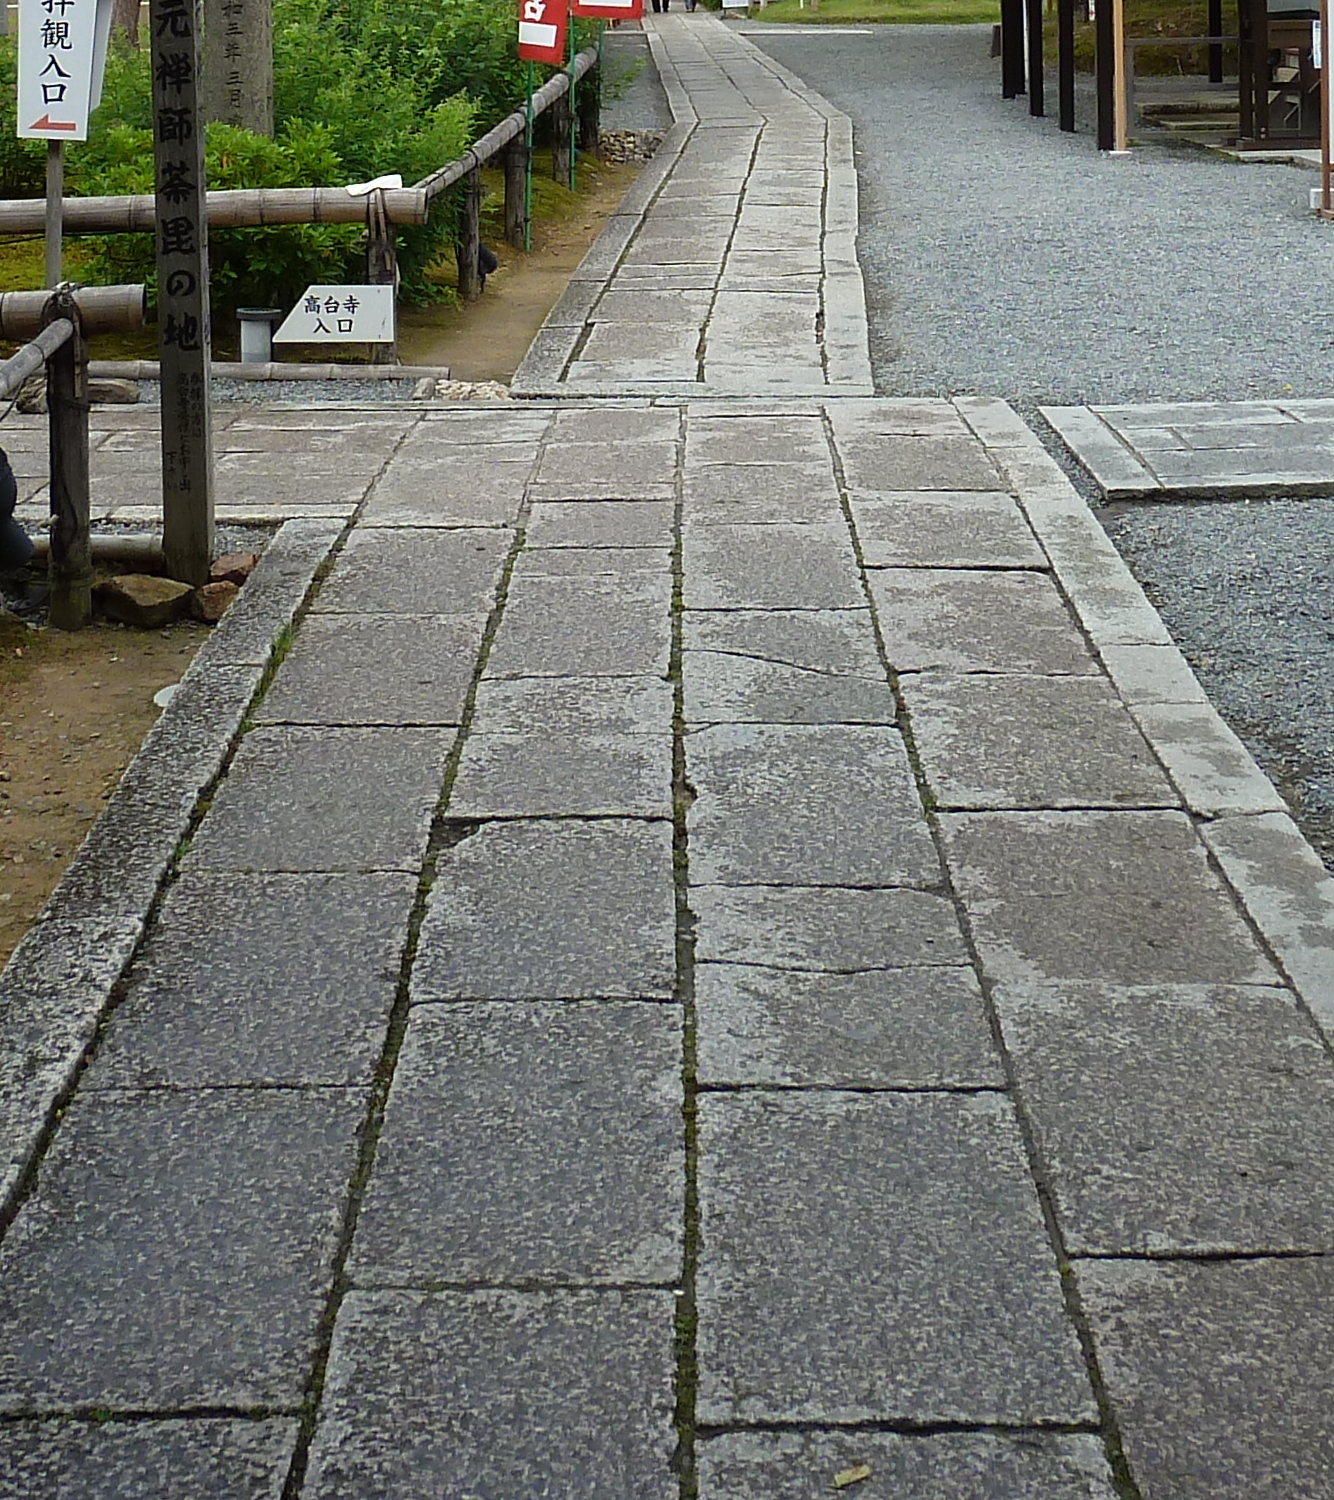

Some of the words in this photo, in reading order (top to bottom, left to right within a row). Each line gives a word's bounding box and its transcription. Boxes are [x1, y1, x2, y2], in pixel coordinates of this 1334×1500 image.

[303, 295, 361, 315] 高台寺
[313, 317, 354, 334] 入口
